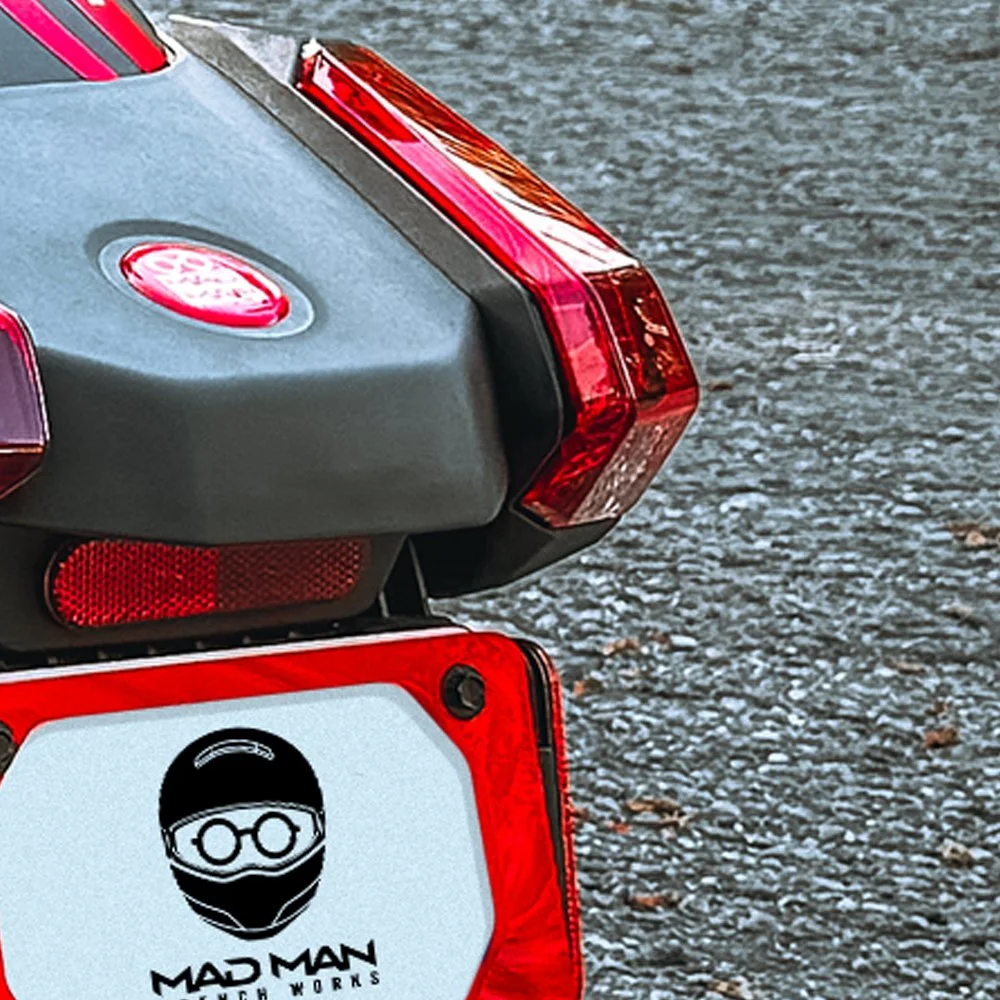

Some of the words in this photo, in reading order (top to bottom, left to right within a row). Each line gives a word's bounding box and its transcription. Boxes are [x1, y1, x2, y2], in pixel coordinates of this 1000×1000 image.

[150, 957, 261, 995] MAD
[269, 939, 377, 978] MAN
[290, 971, 380, 997] WORKS
